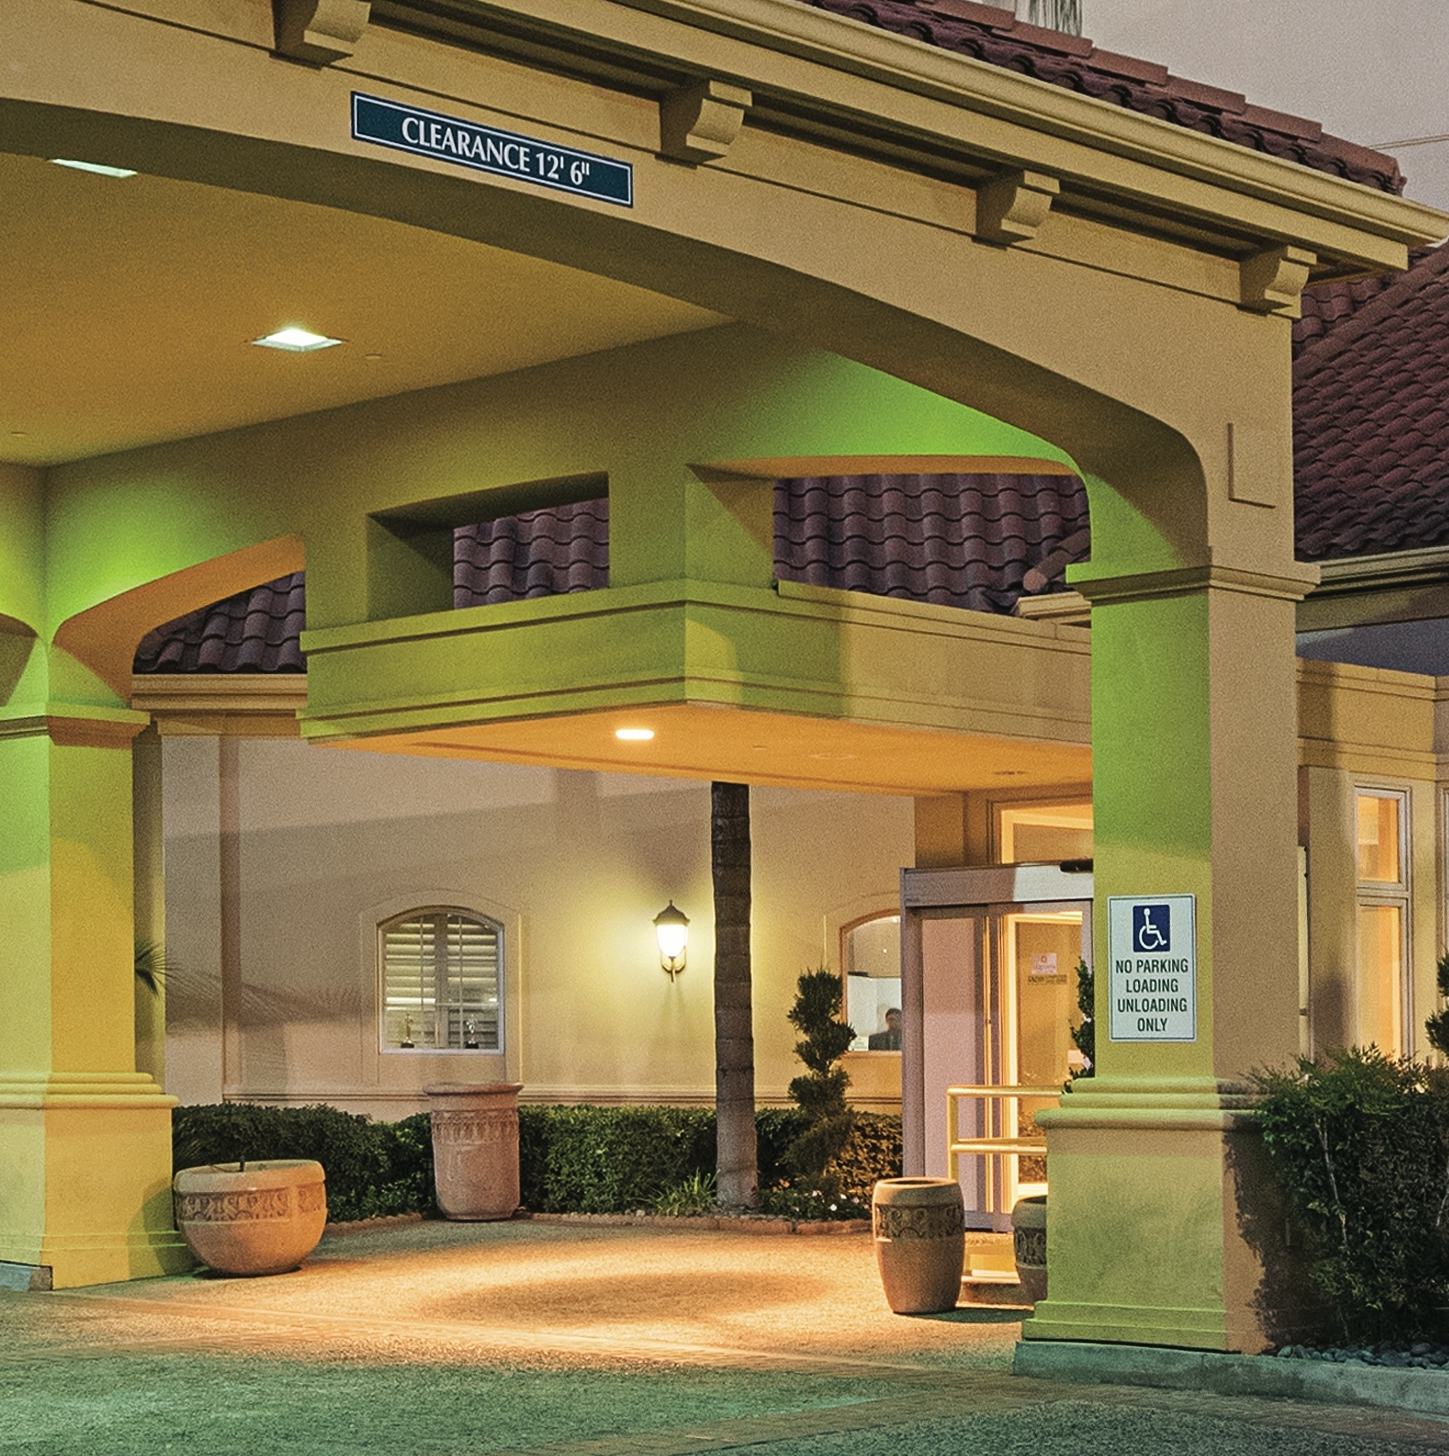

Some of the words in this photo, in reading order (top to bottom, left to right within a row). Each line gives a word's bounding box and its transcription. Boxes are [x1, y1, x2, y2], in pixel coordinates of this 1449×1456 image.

[401, 117, 531, 173] CLEARANCE
[535, 151, 565, 180] 12'
[1115, 960, 1132, 974] NO
[1136, 958, 1189, 974] PARKING
[1125, 978, 1179, 993] LOADING
[1117, 998, 1188, 1013] UNLOADING
[1137, 1018, 1168, 1032] ONLY
